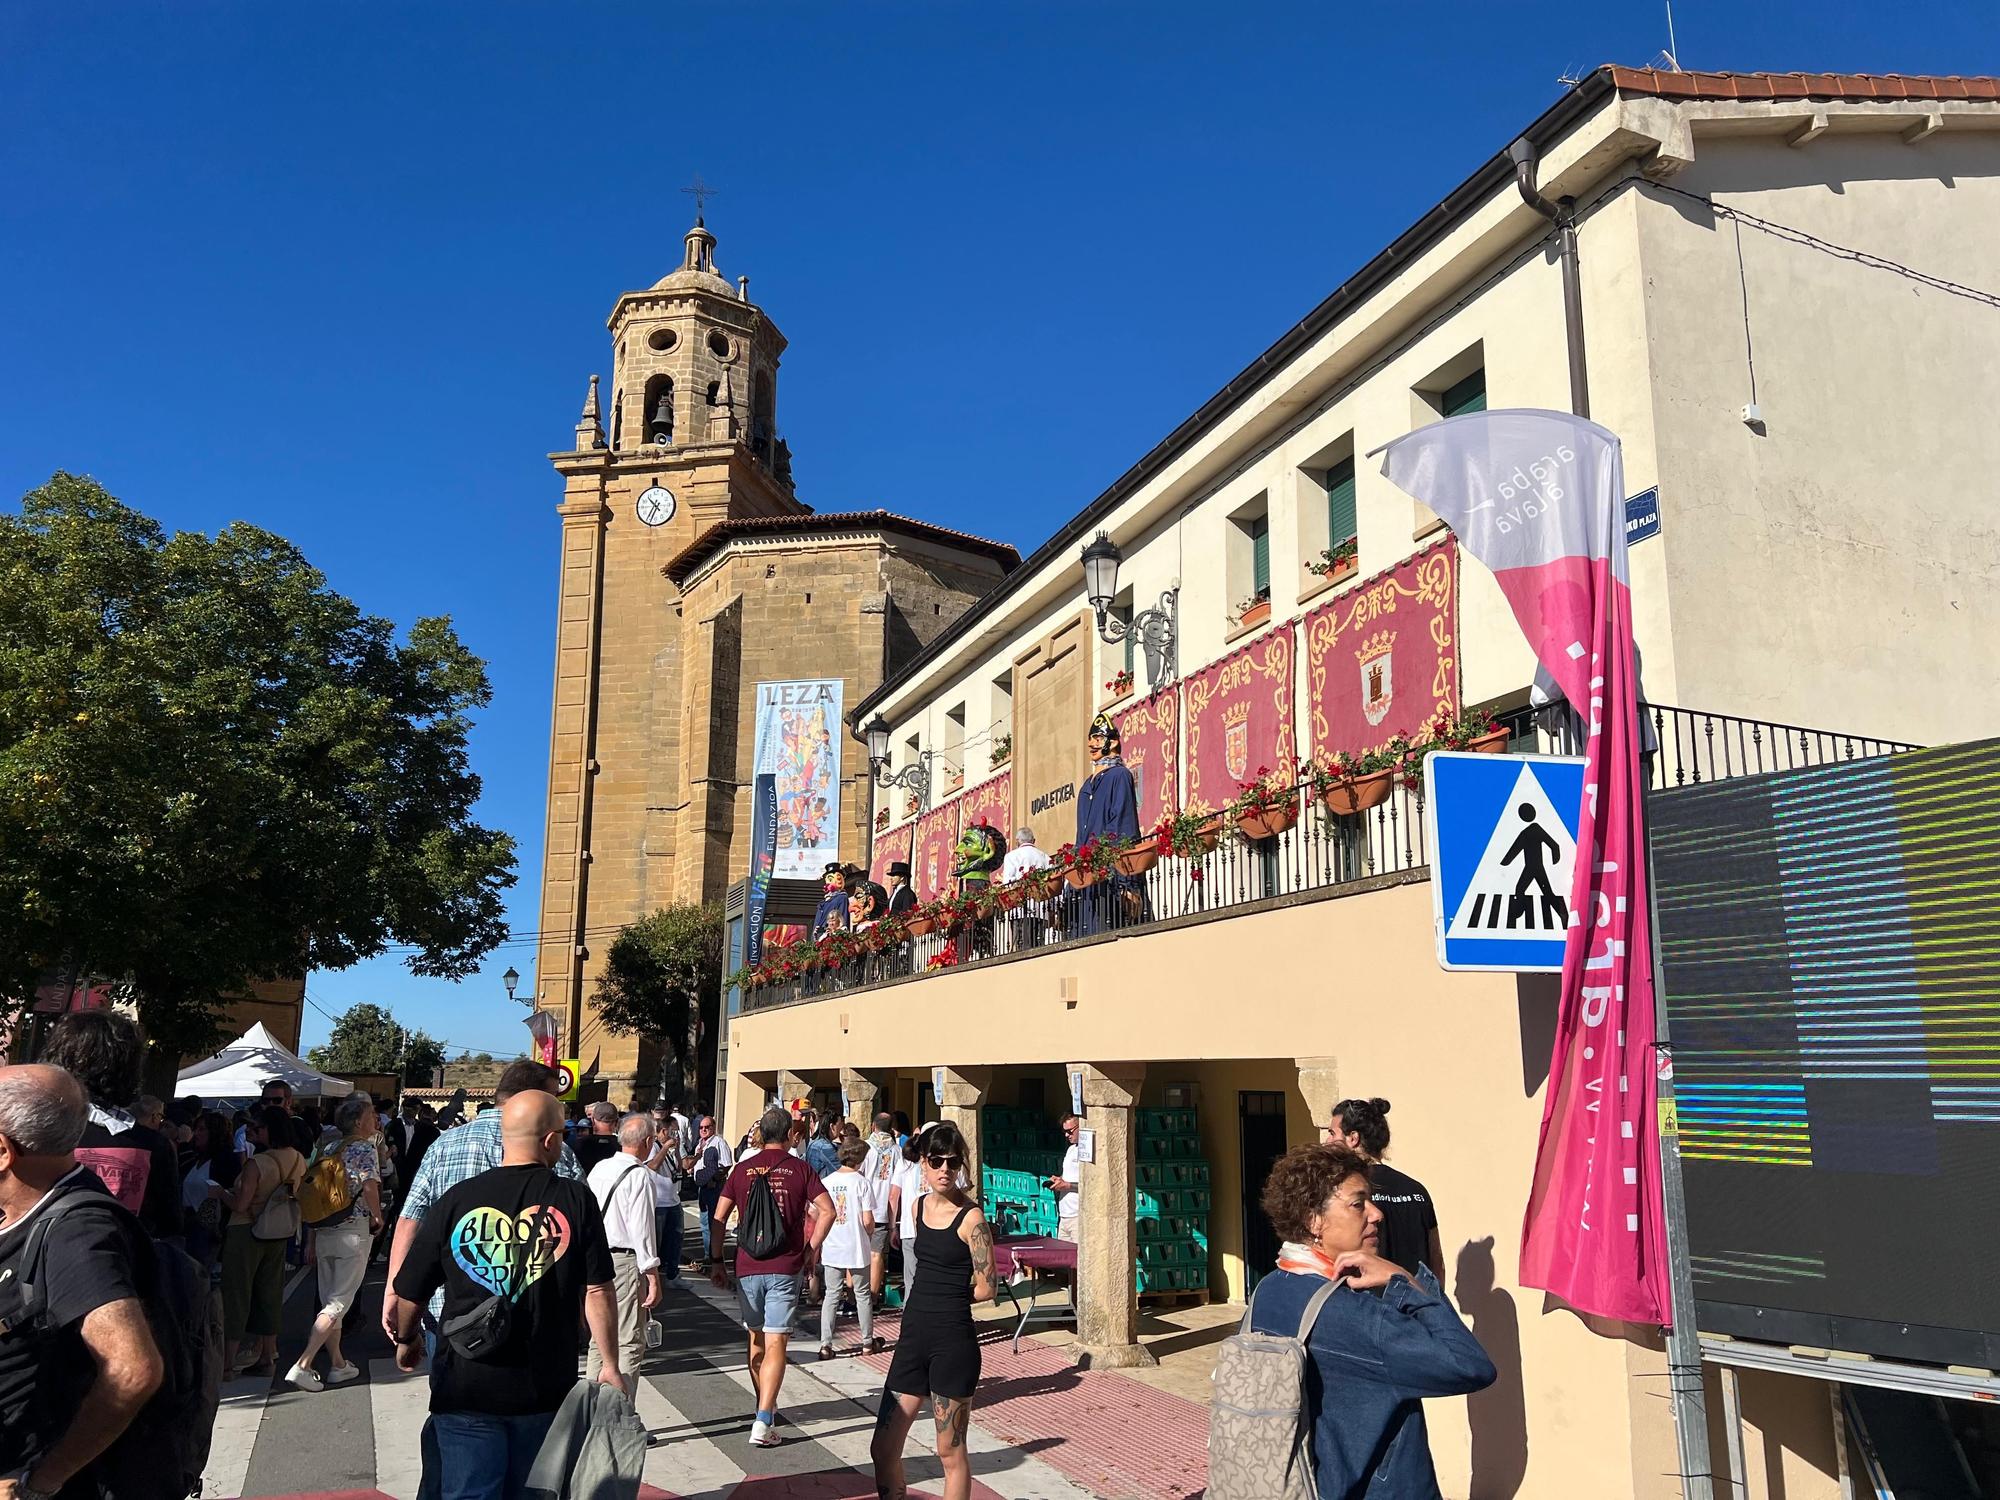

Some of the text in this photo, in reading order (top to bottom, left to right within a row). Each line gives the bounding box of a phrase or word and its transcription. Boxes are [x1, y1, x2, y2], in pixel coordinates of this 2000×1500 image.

[1639, 512, 1657, 528] PLAZA
[765, 684, 834, 706] LEZA
[1031, 783, 1075, 816] UDALETXEA
[767, 786, 777, 851] FUNDAZIOA
